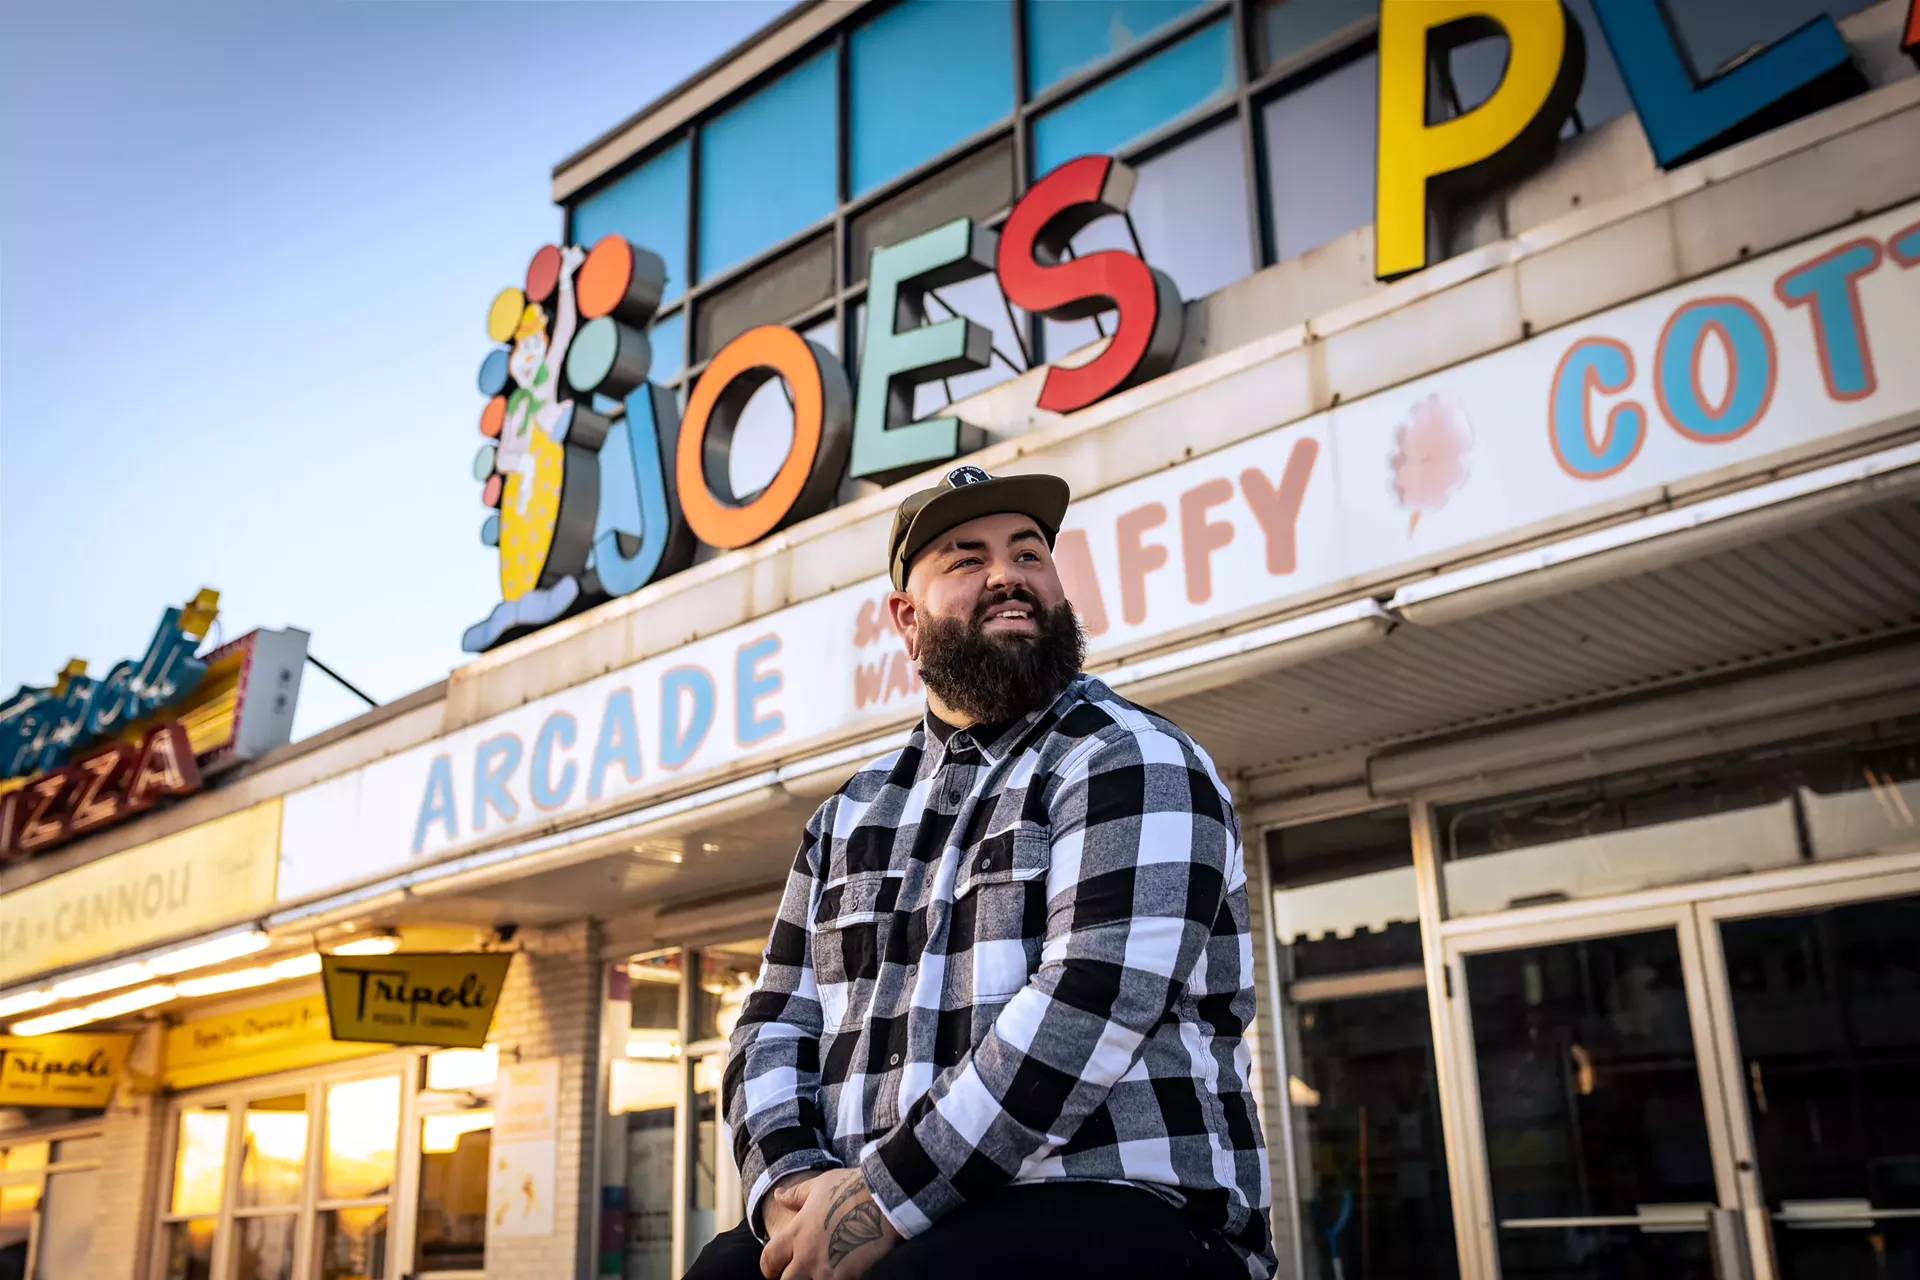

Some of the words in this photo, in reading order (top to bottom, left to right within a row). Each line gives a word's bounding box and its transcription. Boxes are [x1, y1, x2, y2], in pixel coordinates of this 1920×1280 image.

[594, 154, 1158, 597] JOES
[1375, 0, 1920, 280] PL
[1052, 437, 1320, 637] AFFY
[853, 591, 900, 648] SA
[411, 632, 786, 856] ARCADE
[53, 863, 191, 943] CANNOLI
[335, 966, 488, 1024] Tripoli
